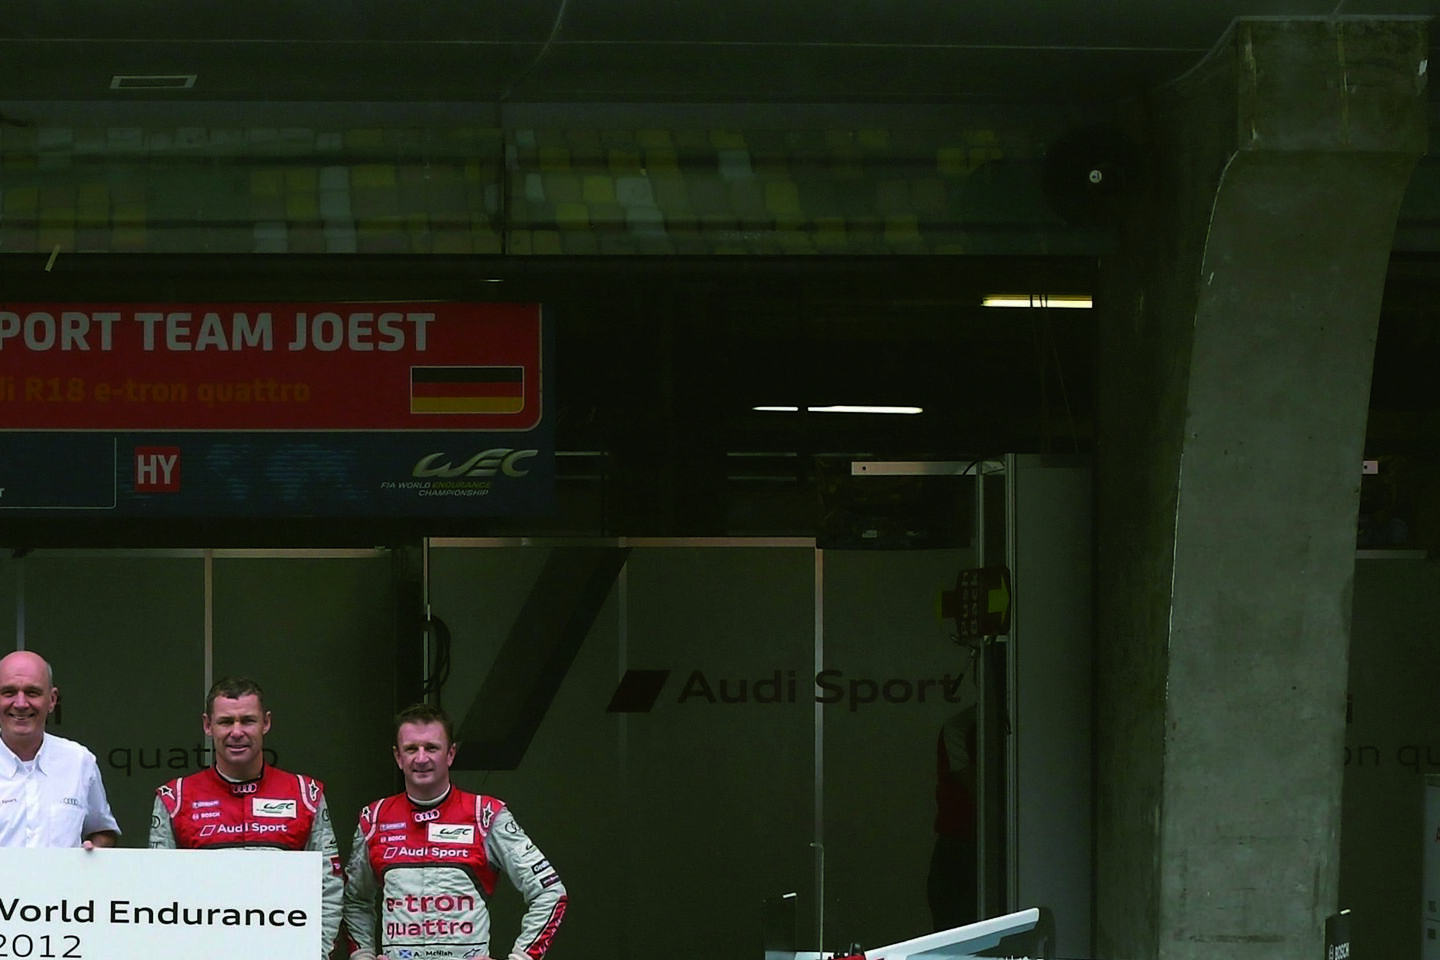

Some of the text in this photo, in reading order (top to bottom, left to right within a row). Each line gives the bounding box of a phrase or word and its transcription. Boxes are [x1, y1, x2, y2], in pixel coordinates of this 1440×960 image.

[135, 312, 273, 351] TEAM
[288, 312, 435, 352] JOEST
[24, 378, 85, 401] R18
[94, 378, 187, 401] e-tron
[197, 379, 310, 408] quattro
[137, 454, 178, 484] HY
[412, 448, 538, 478] WEC
[380, 481, 491, 490] FIA WORLD ENDURANCE
[418, 489, 489, 497] CHAMPIONSHIP
[678, 669, 961, 712] Audi Sport
[217, 823, 288, 834] Audi Sport
[399, 847, 469, 859] Audi Sport
[110, 900, 307, 927] Endurance
[386, 894, 474, 912] e-tron
[386, 919, 474, 939] quattro
